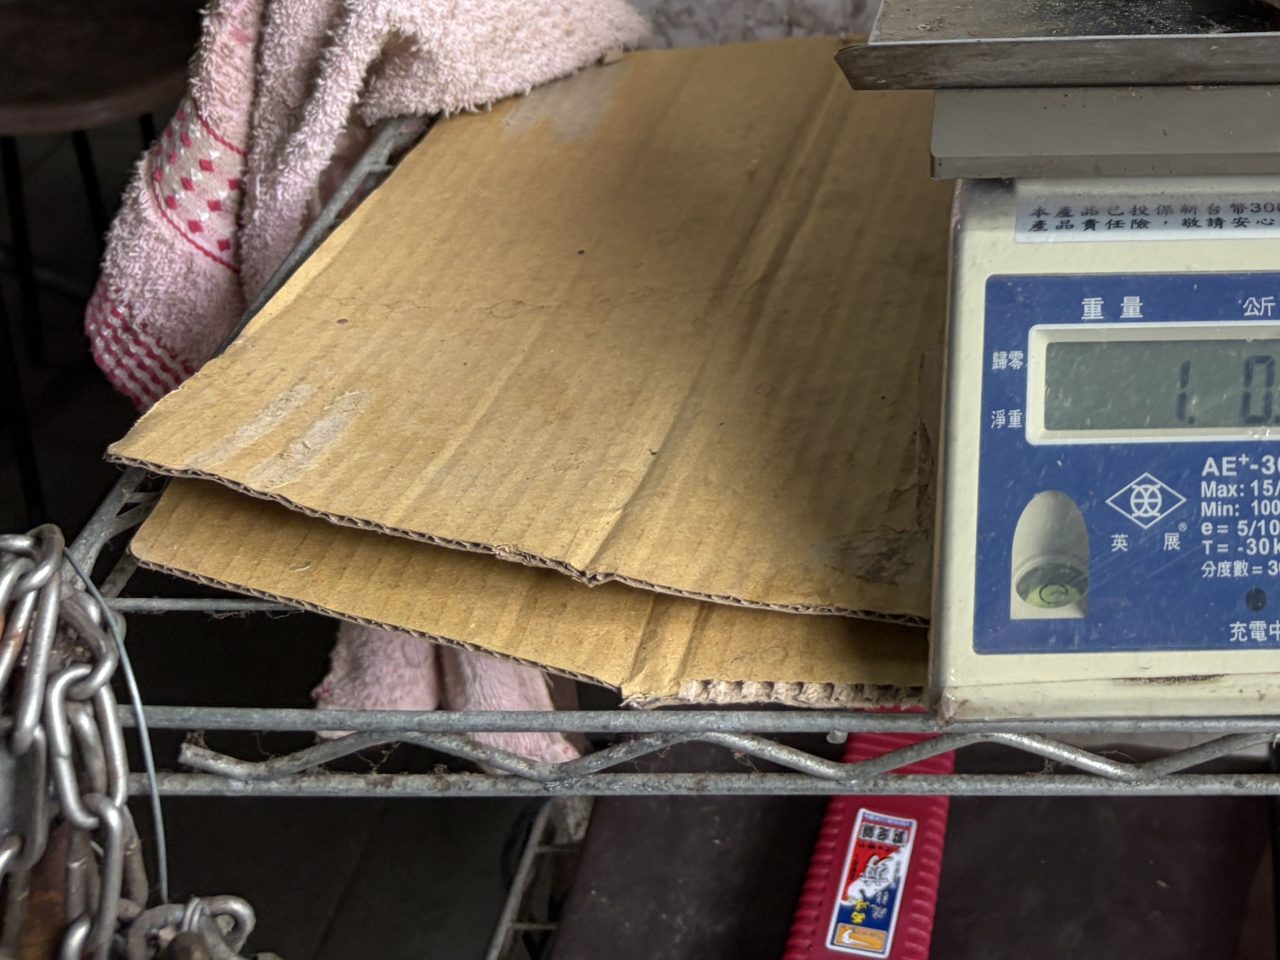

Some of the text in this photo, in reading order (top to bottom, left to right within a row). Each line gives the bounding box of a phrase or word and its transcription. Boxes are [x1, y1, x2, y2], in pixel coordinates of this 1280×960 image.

[1081, 296, 1144, 320] 重量
[992, 350, 1025, 371] 歸零
[990, 408, 1024, 429] 淨重
[1201, 480, 1245, 498] Max:
[1201, 501, 1240, 517] Min:
